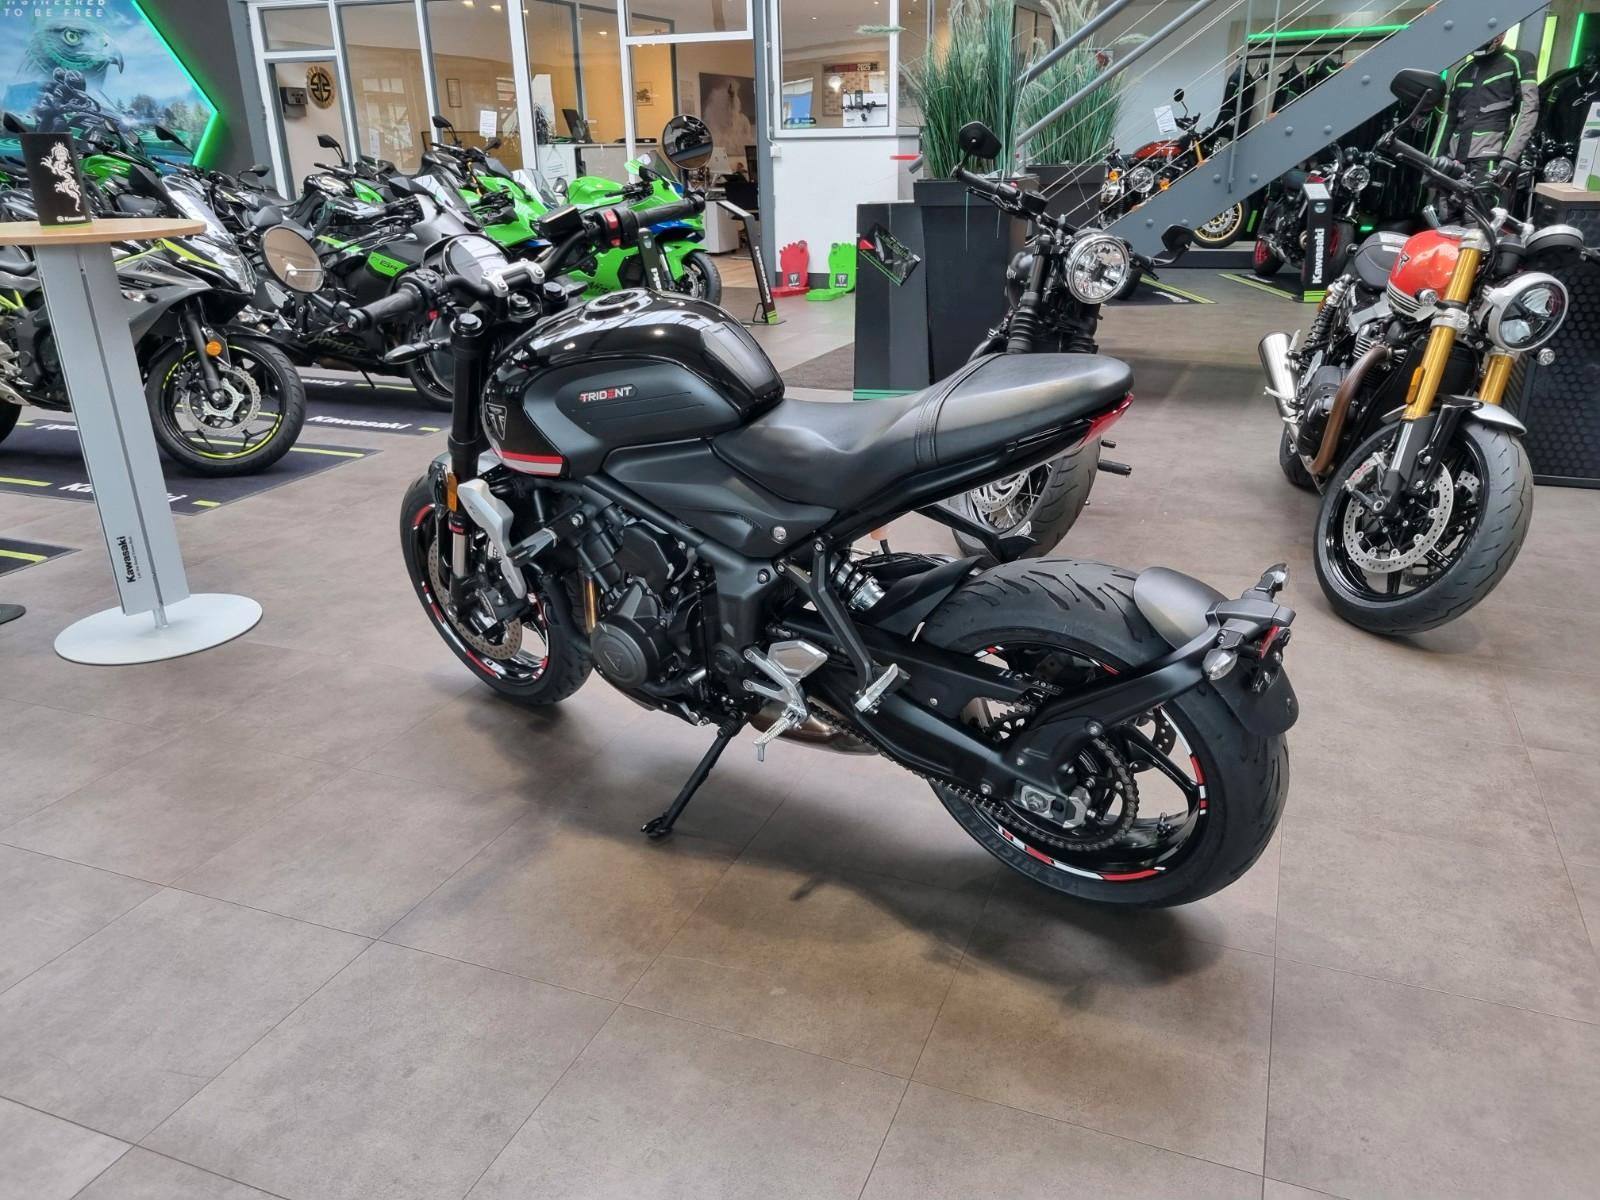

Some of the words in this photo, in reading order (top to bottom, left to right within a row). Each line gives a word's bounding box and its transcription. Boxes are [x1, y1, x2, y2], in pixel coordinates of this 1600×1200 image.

[4, 8, 23, 17] TO
[34, 8, 53, 17] BE
[64, 8, 103, 18] FREE
[856, 63, 871, 71] 2025
[1312, 228, 1325, 284] Kawasaki
[579, 386, 632, 403] TRIDENT
[116, 535, 136, 583] Kawasaki
